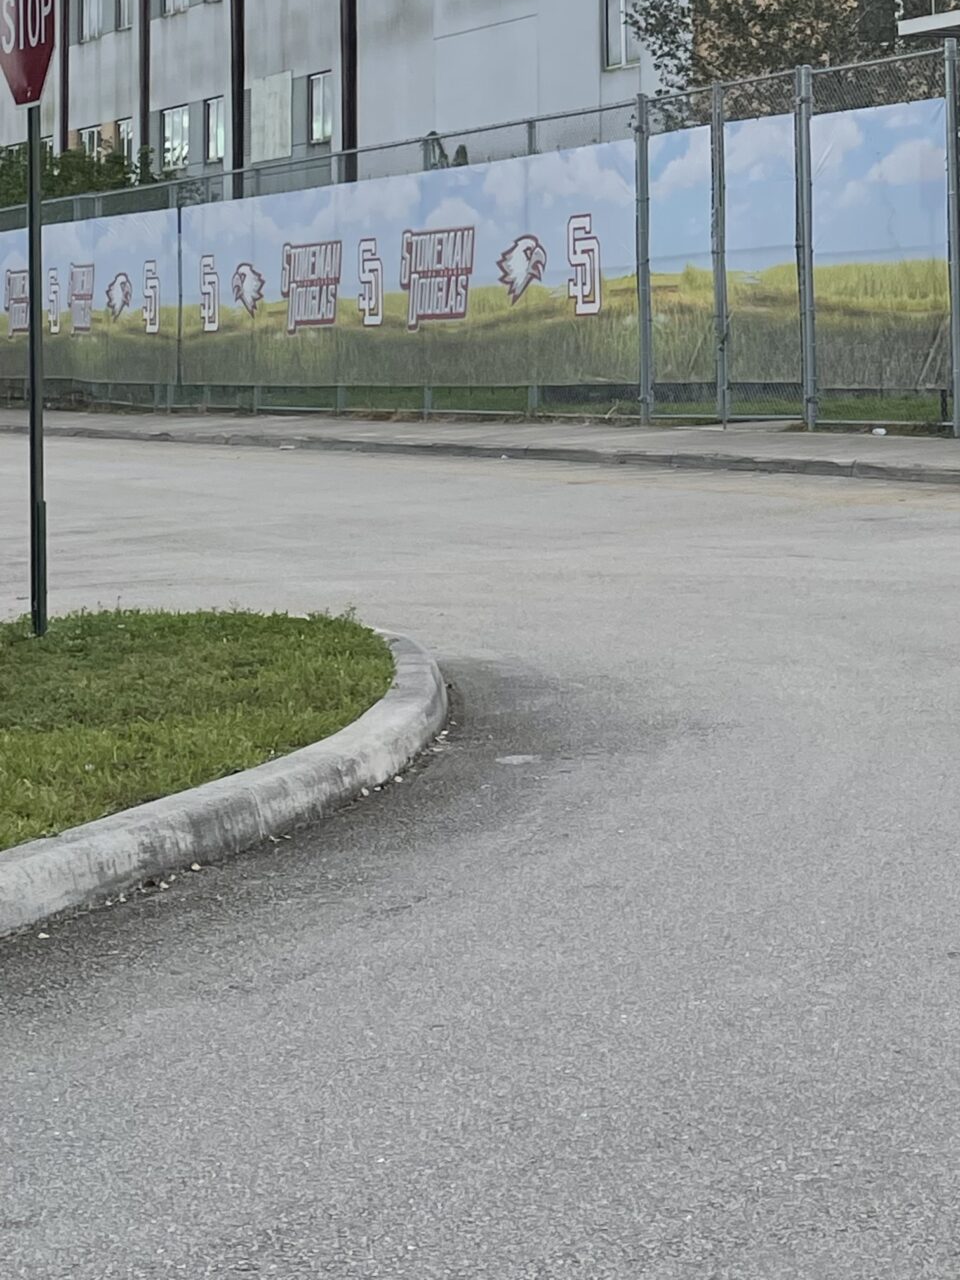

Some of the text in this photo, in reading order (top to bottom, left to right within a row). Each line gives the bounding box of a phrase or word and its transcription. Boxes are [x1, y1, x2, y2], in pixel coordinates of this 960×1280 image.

[281, 240, 342, 298] STONEMAN
[358, 238, 383, 327] SD
[400, 227, 474, 290] STONEMAN
[567, 213, 601, 316] SD
[199, 254, 219, 333] SD
[287, 281, 337, 335] DOUGLAS
[407, 272, 468, 331] DOUGLAS
